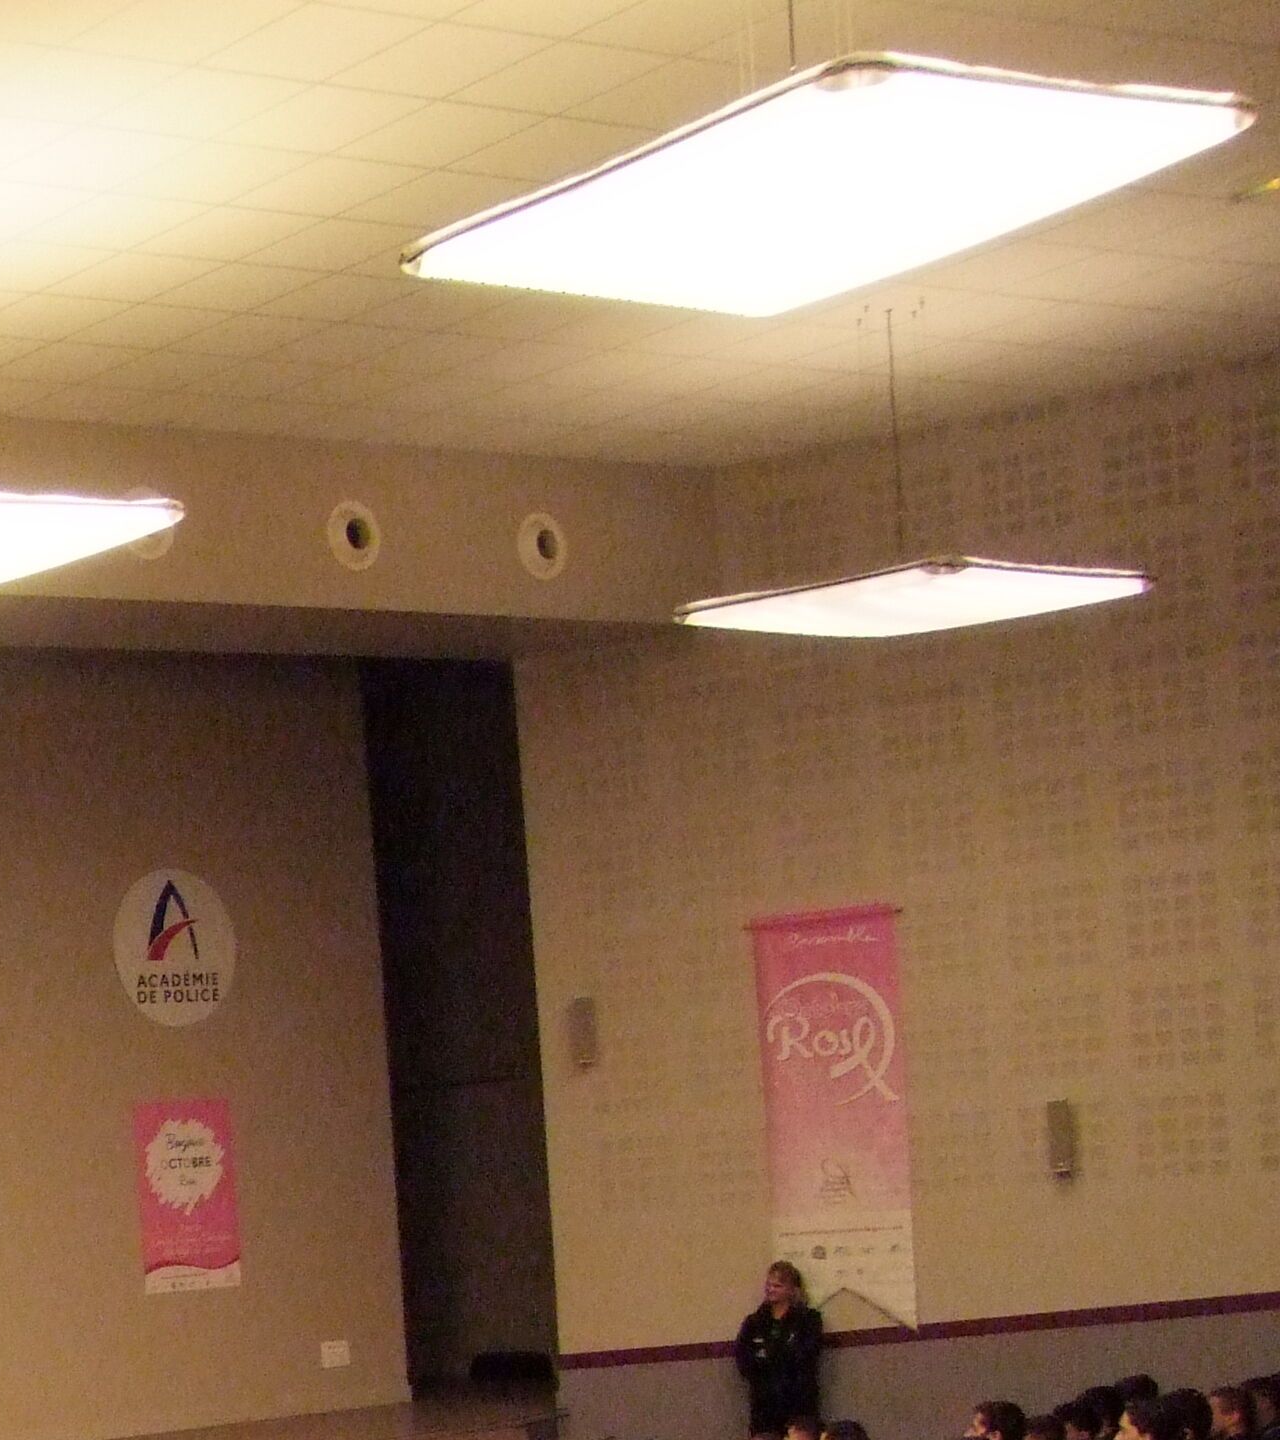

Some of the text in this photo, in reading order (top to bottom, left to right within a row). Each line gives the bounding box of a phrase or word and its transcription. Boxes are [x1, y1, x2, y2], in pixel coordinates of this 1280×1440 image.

[137, 970, 219, 988] ACADÉMIE
[137, 988, 220, 1004] DE POLICE
